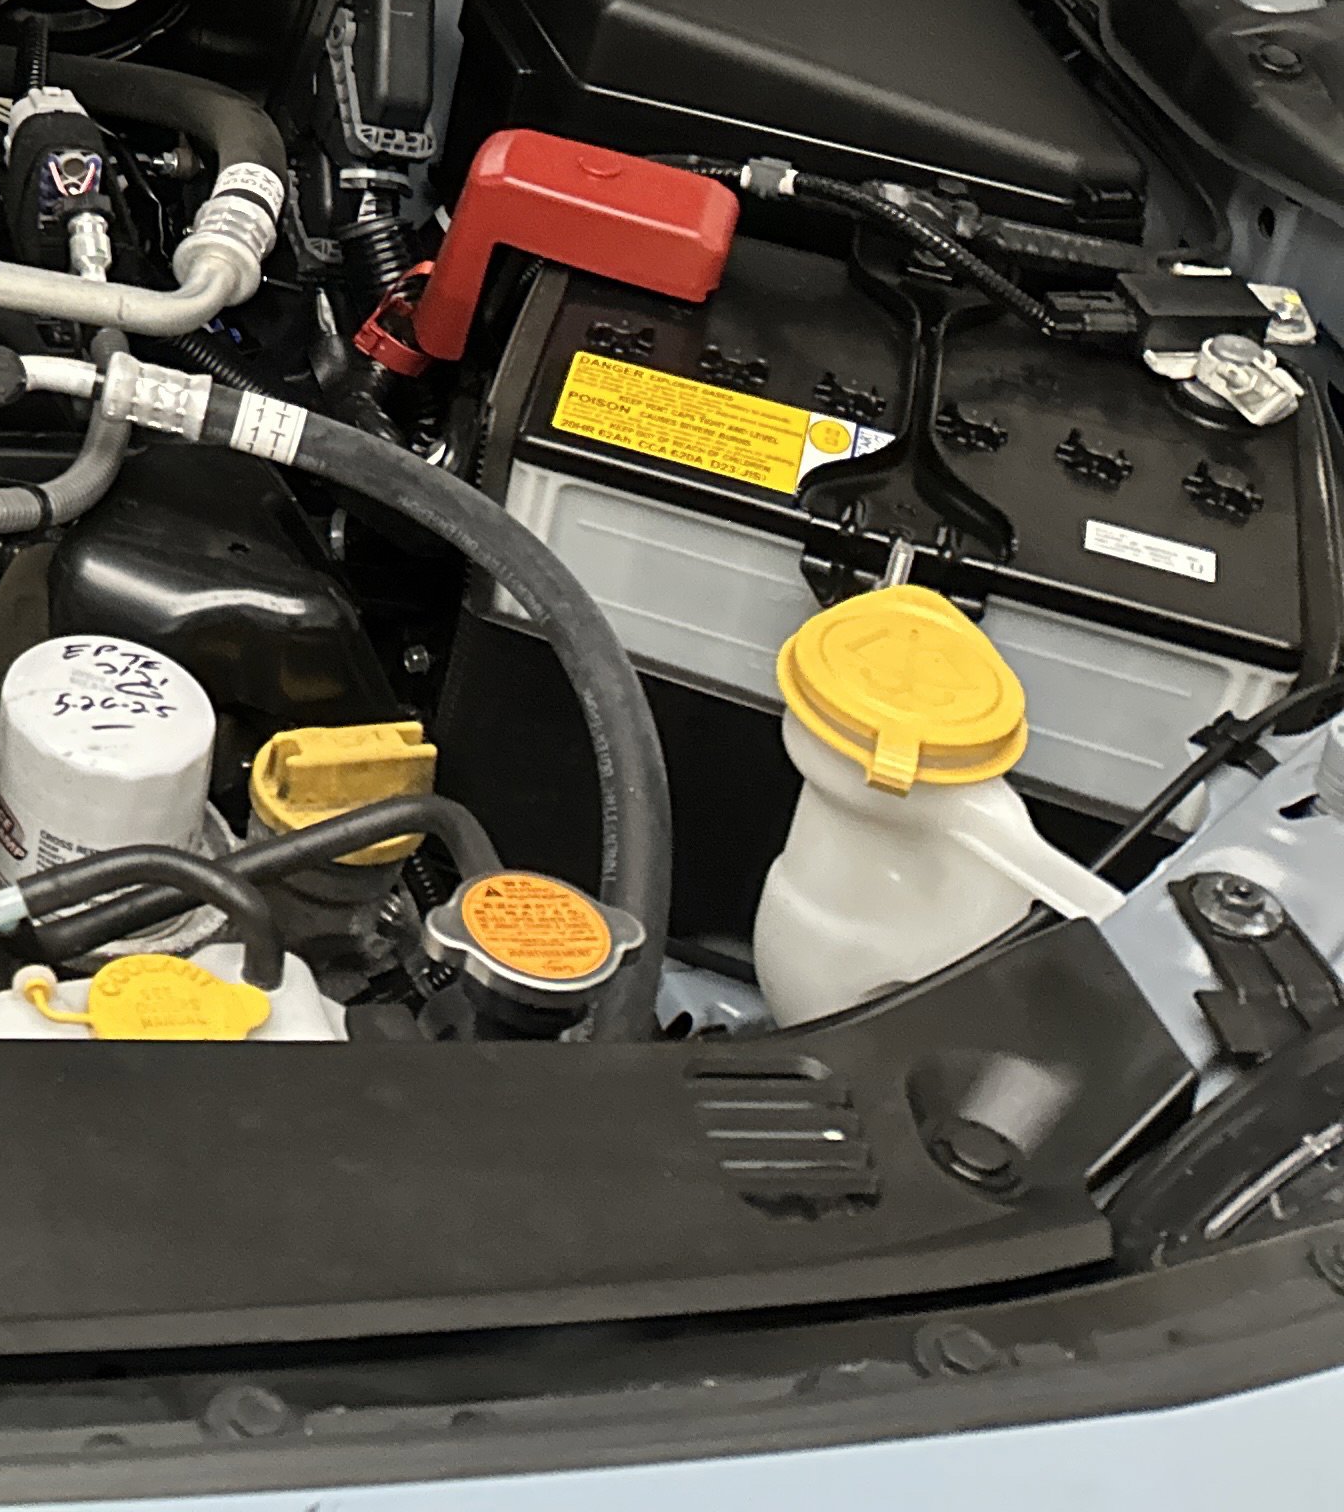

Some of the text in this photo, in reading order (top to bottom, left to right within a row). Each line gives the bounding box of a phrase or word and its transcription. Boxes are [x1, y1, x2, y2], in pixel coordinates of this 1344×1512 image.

[580, 355, 645, 379] DANGER
[568, 391, 631, 414] POISON
[638, 440, 667, 455] CCA
[98, 957, 220, 998] COOLANT
